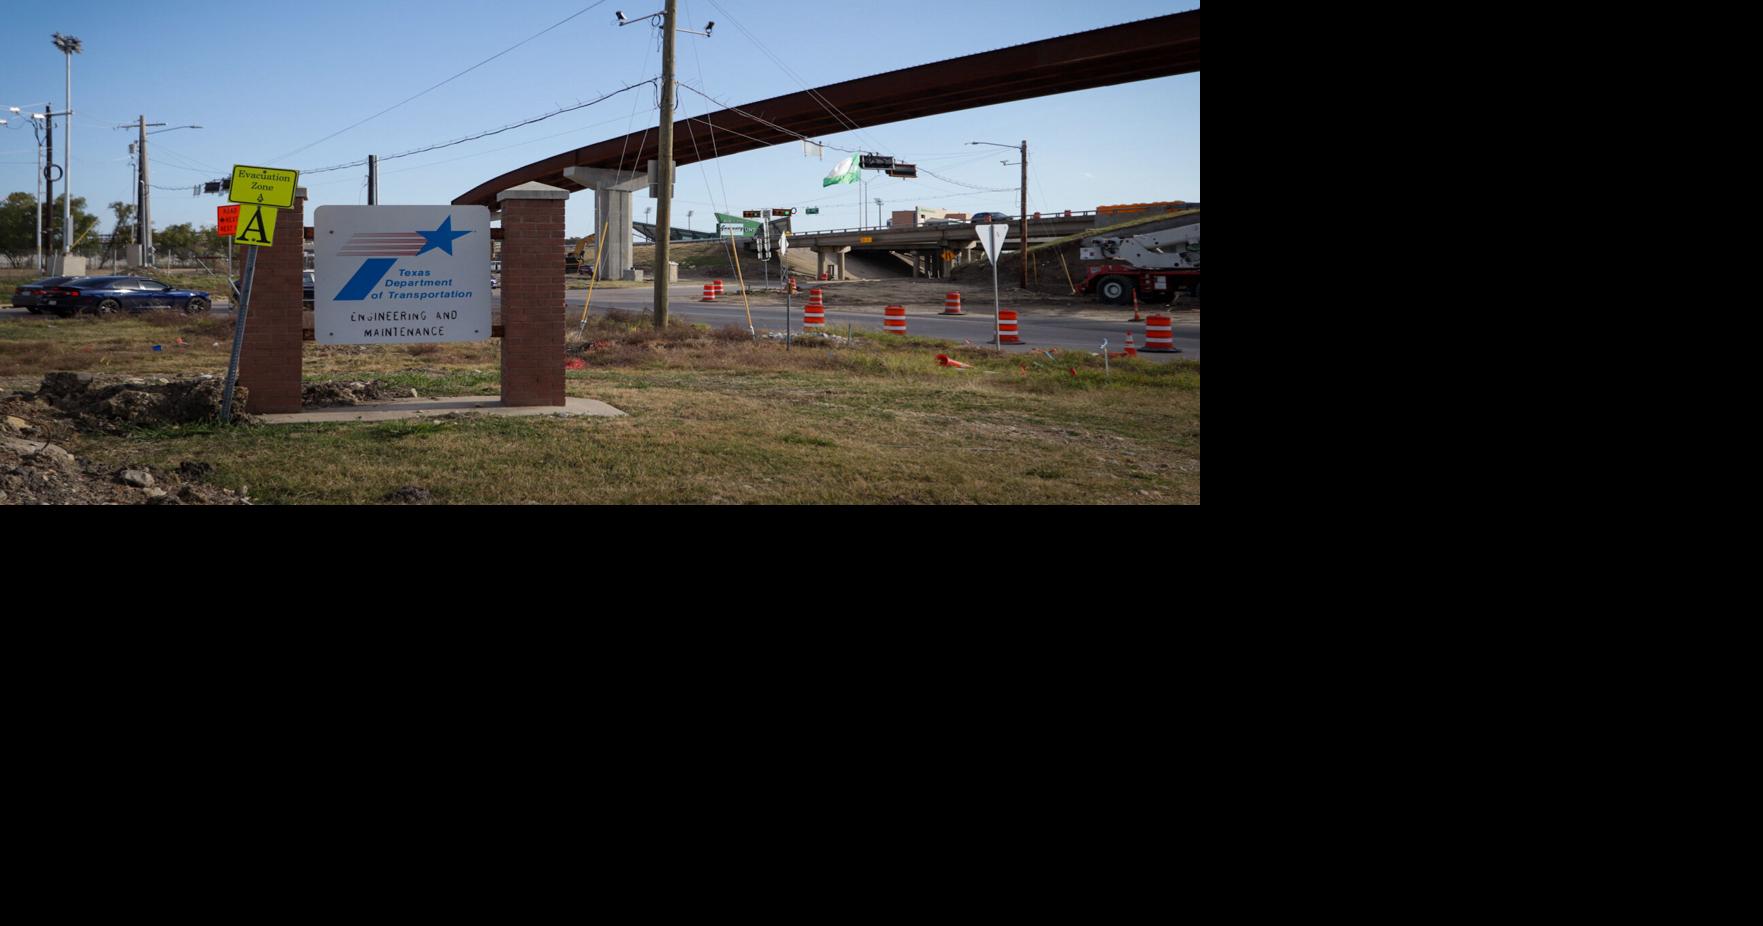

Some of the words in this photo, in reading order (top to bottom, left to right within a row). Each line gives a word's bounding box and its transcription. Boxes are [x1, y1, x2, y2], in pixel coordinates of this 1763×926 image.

[238, 169, 290, 182] Evacuation
[250, 181, 274, 191] Zone
[236, 205, 271, 243] A
[398, 269, 431, 277] Texas
[384, 279, 453, 288] Department
[371, 291, 383, 300] of
[389, 290, 473, 300] Transportation
[435, 310, 458, 320] AND
[363, 326, 445, 337] MAINTENANCE
